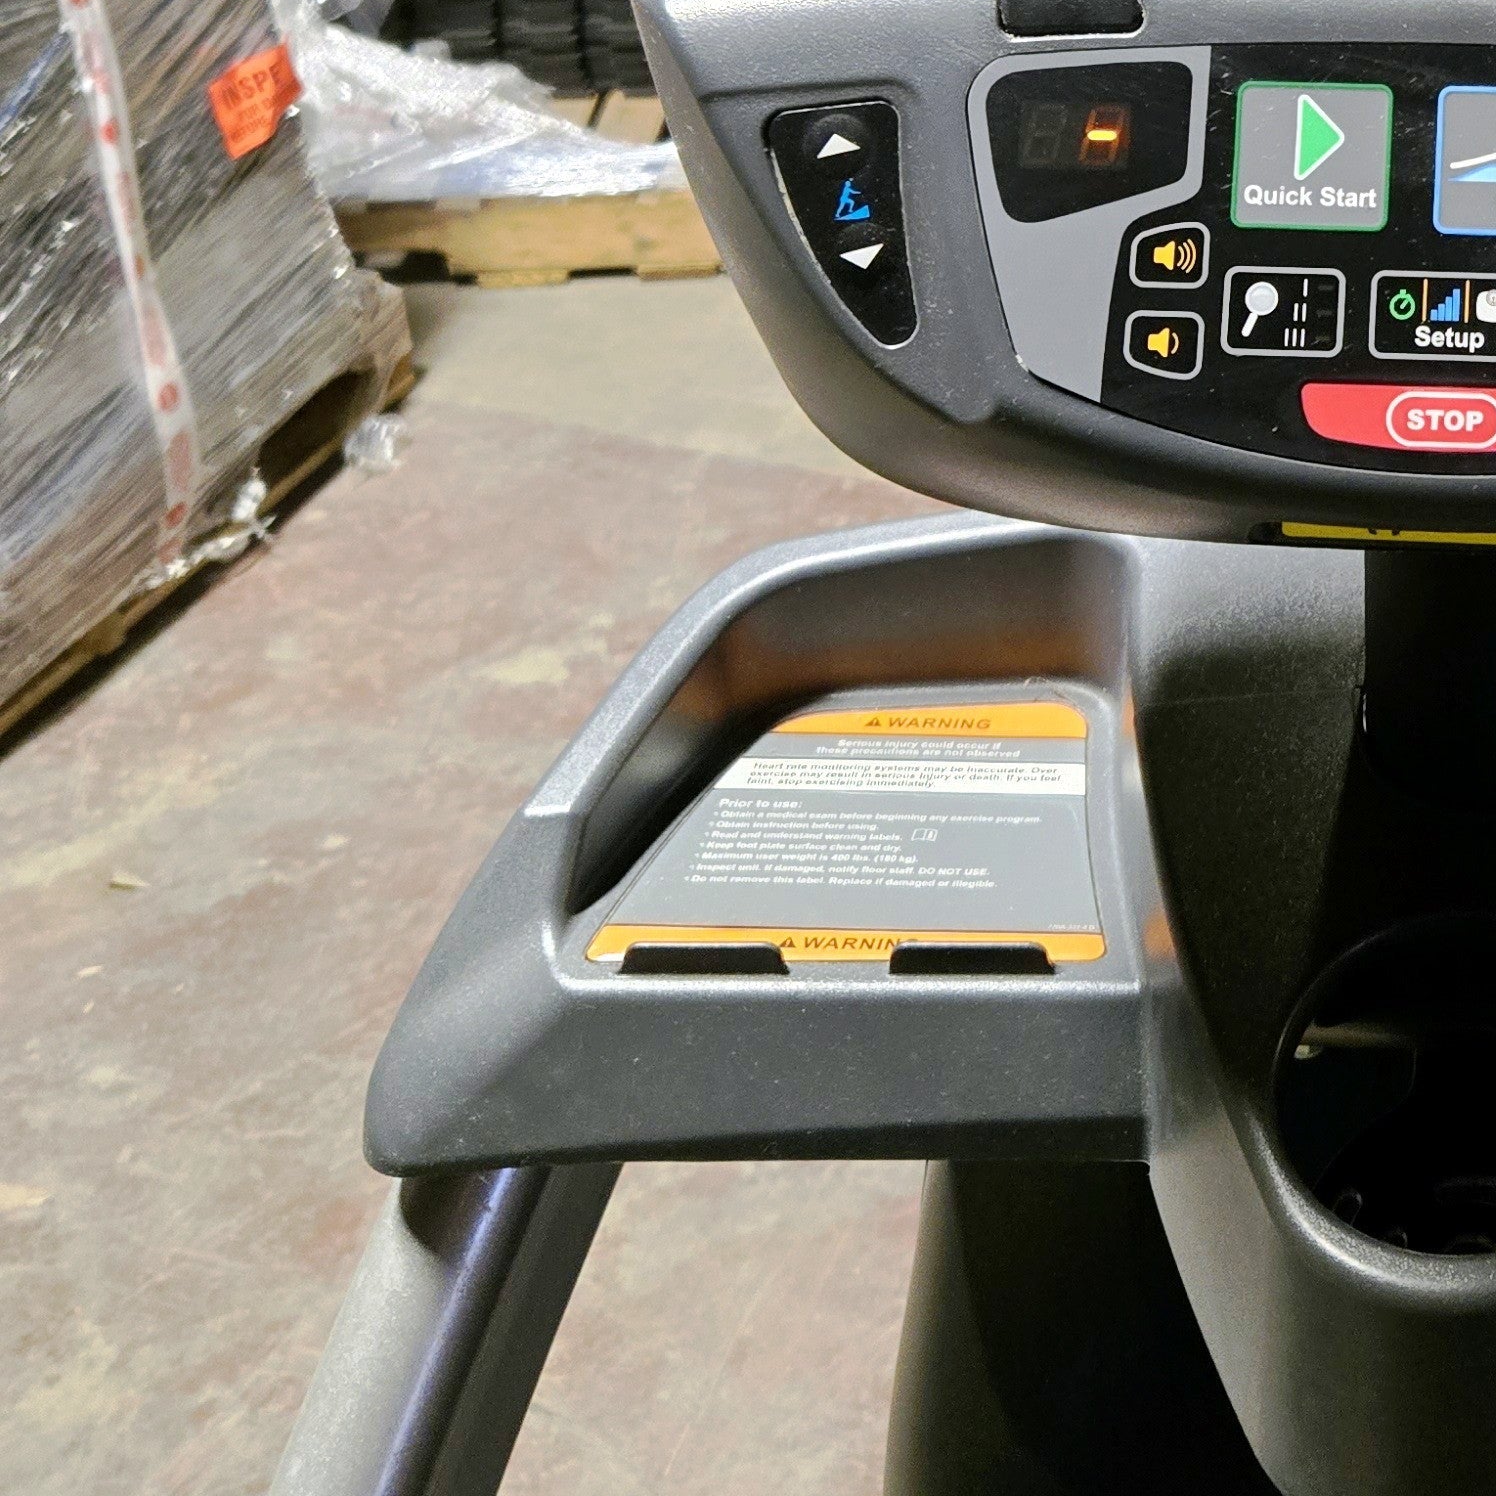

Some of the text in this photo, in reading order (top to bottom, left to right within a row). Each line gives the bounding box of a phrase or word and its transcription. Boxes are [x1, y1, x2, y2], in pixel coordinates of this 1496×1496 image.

[1243, 184, 1377, 208] Quick Start
[1414, 326, 1485, 353] Setup
[1407, 408, 1484, 432] STOP
[888, 716, 991, 730] WARNING
[718, 798, 803, 809] Prior to use:
[803, 937, 918, 951] WARNIN
